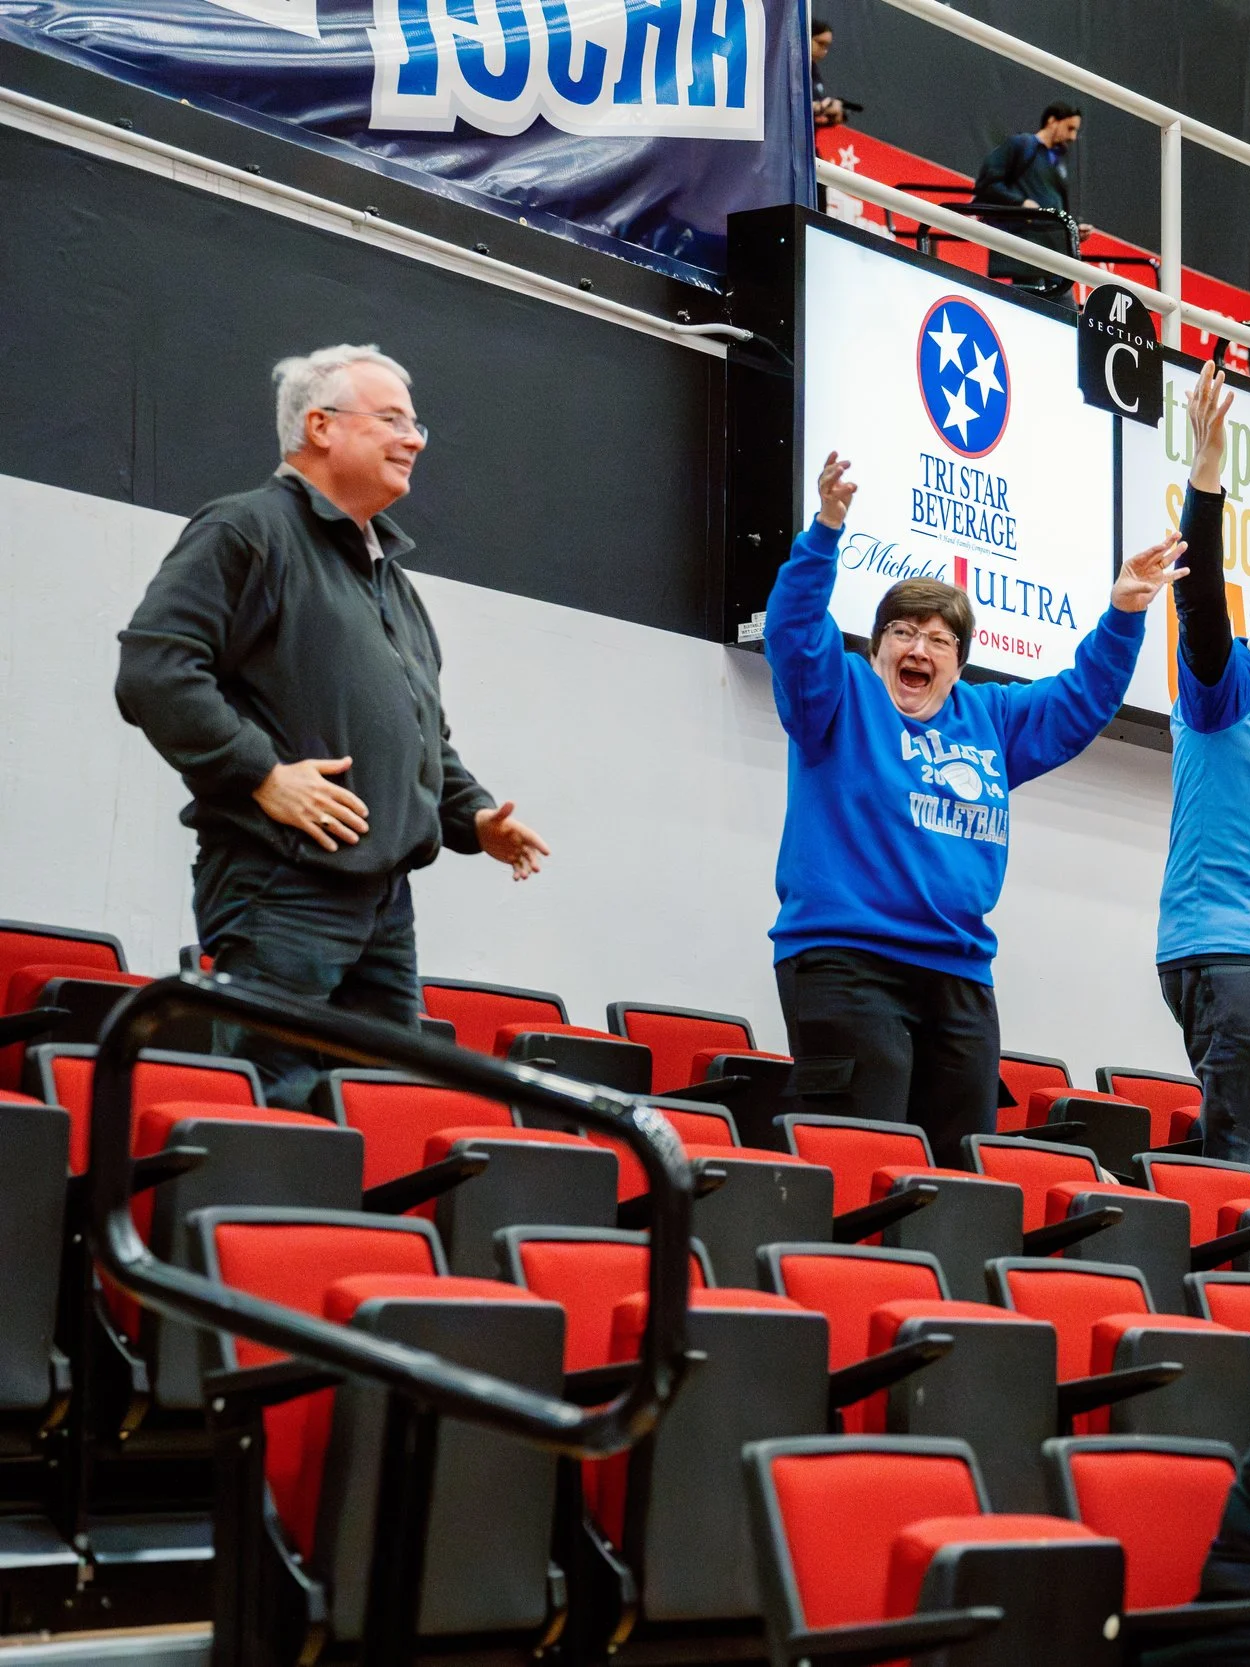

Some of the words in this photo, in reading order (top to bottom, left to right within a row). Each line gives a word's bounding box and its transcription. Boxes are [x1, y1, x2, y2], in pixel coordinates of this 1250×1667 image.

[1088, 318, 1155, 351] SECTION
[1105, 342, 1139, 413] C
[920, 453, 955, 495] TRI
[960, 466, 1010, 512] STAR
[911, 488, 1017, 551] BEVERAGE
[974, 567, 1078, 630] ULTRA
